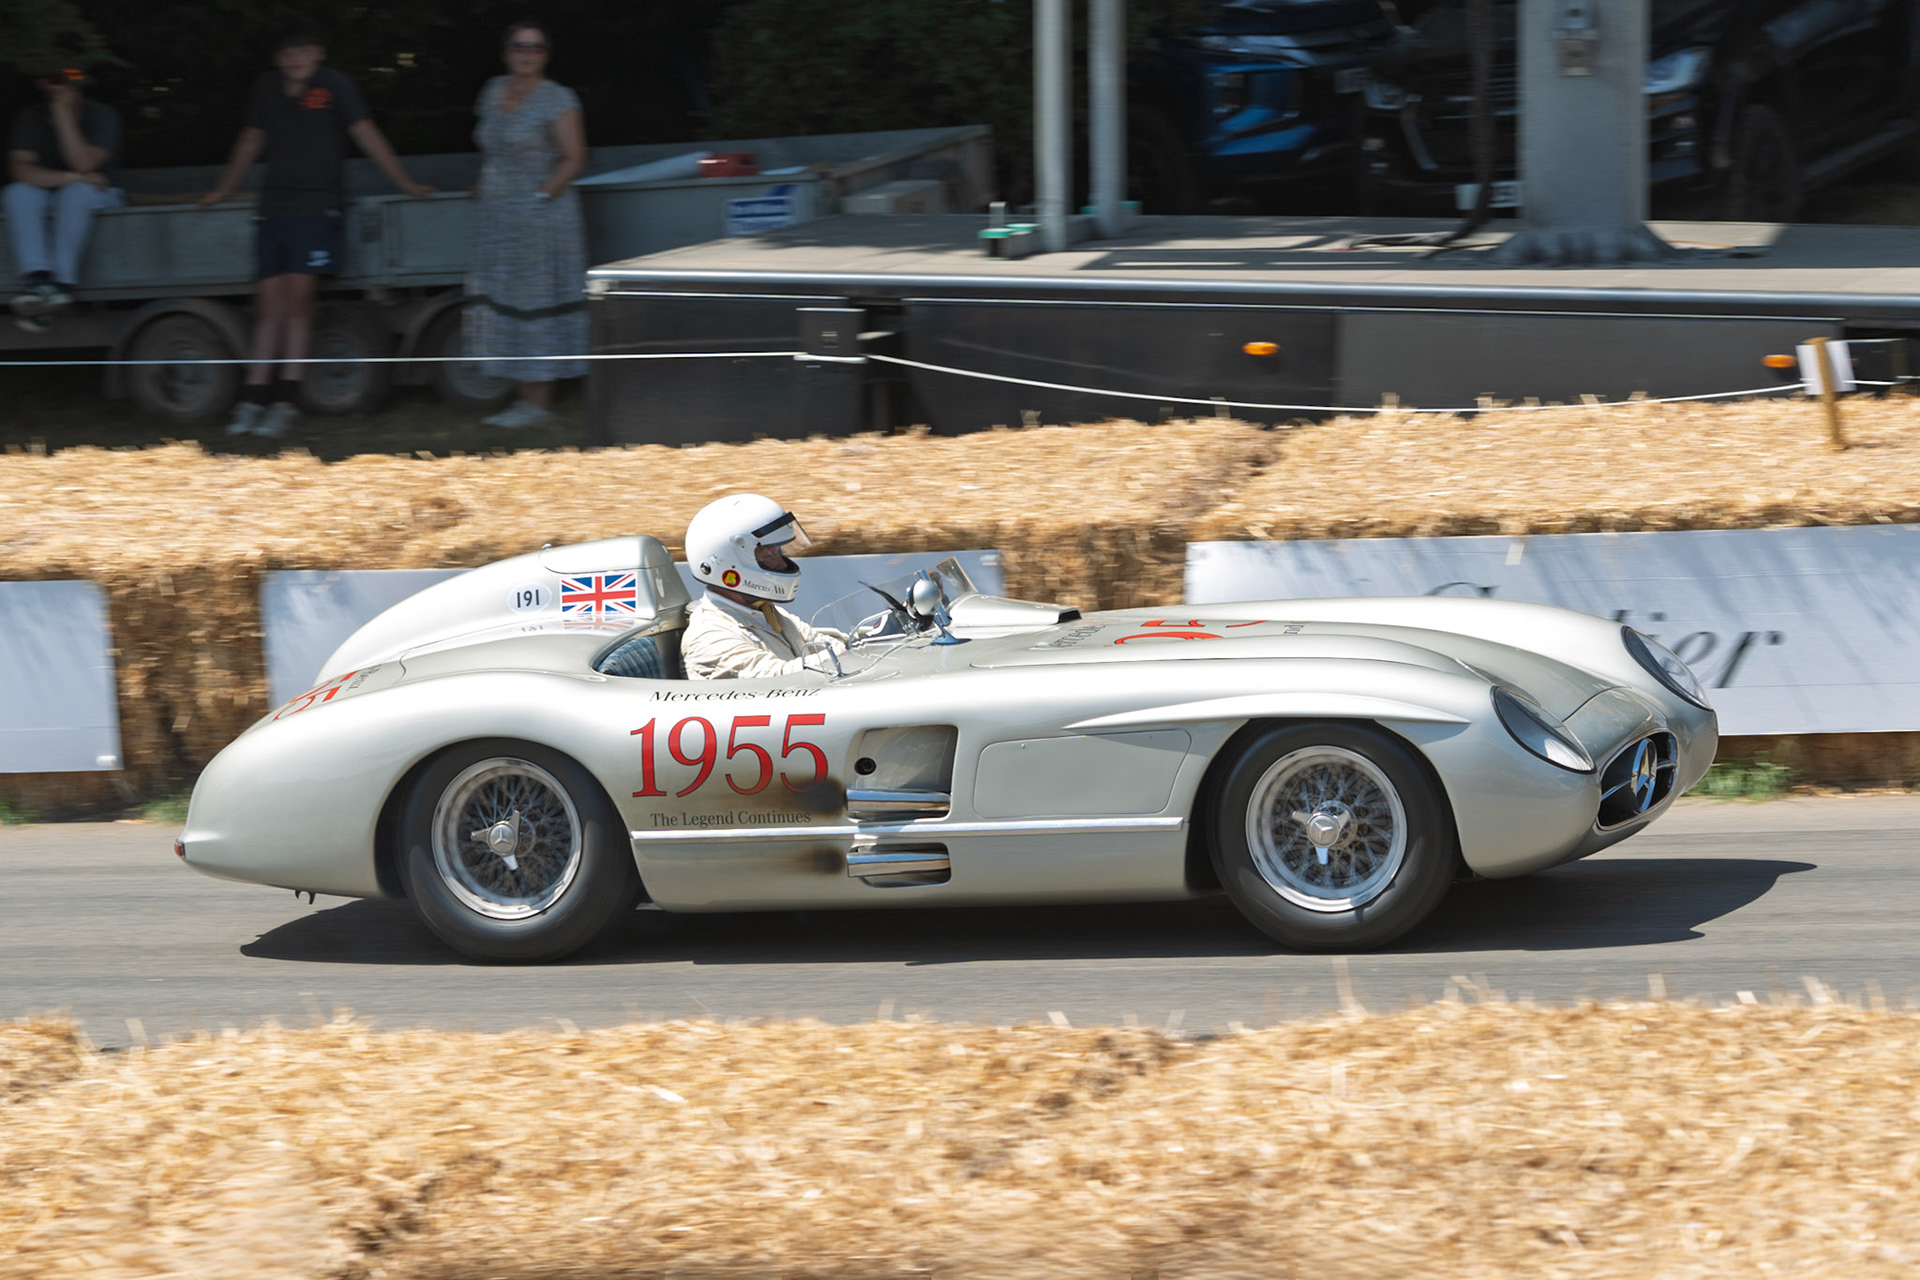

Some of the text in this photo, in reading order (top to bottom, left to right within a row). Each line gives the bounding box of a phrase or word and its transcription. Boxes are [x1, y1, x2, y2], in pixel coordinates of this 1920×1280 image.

[516, 589, 540, 608] 191
[650, 688, 821, 702] Mercedes-Benz
[630, 713, 829, 798] 1955
[650, 810, 811, 828] The Legend Continues
